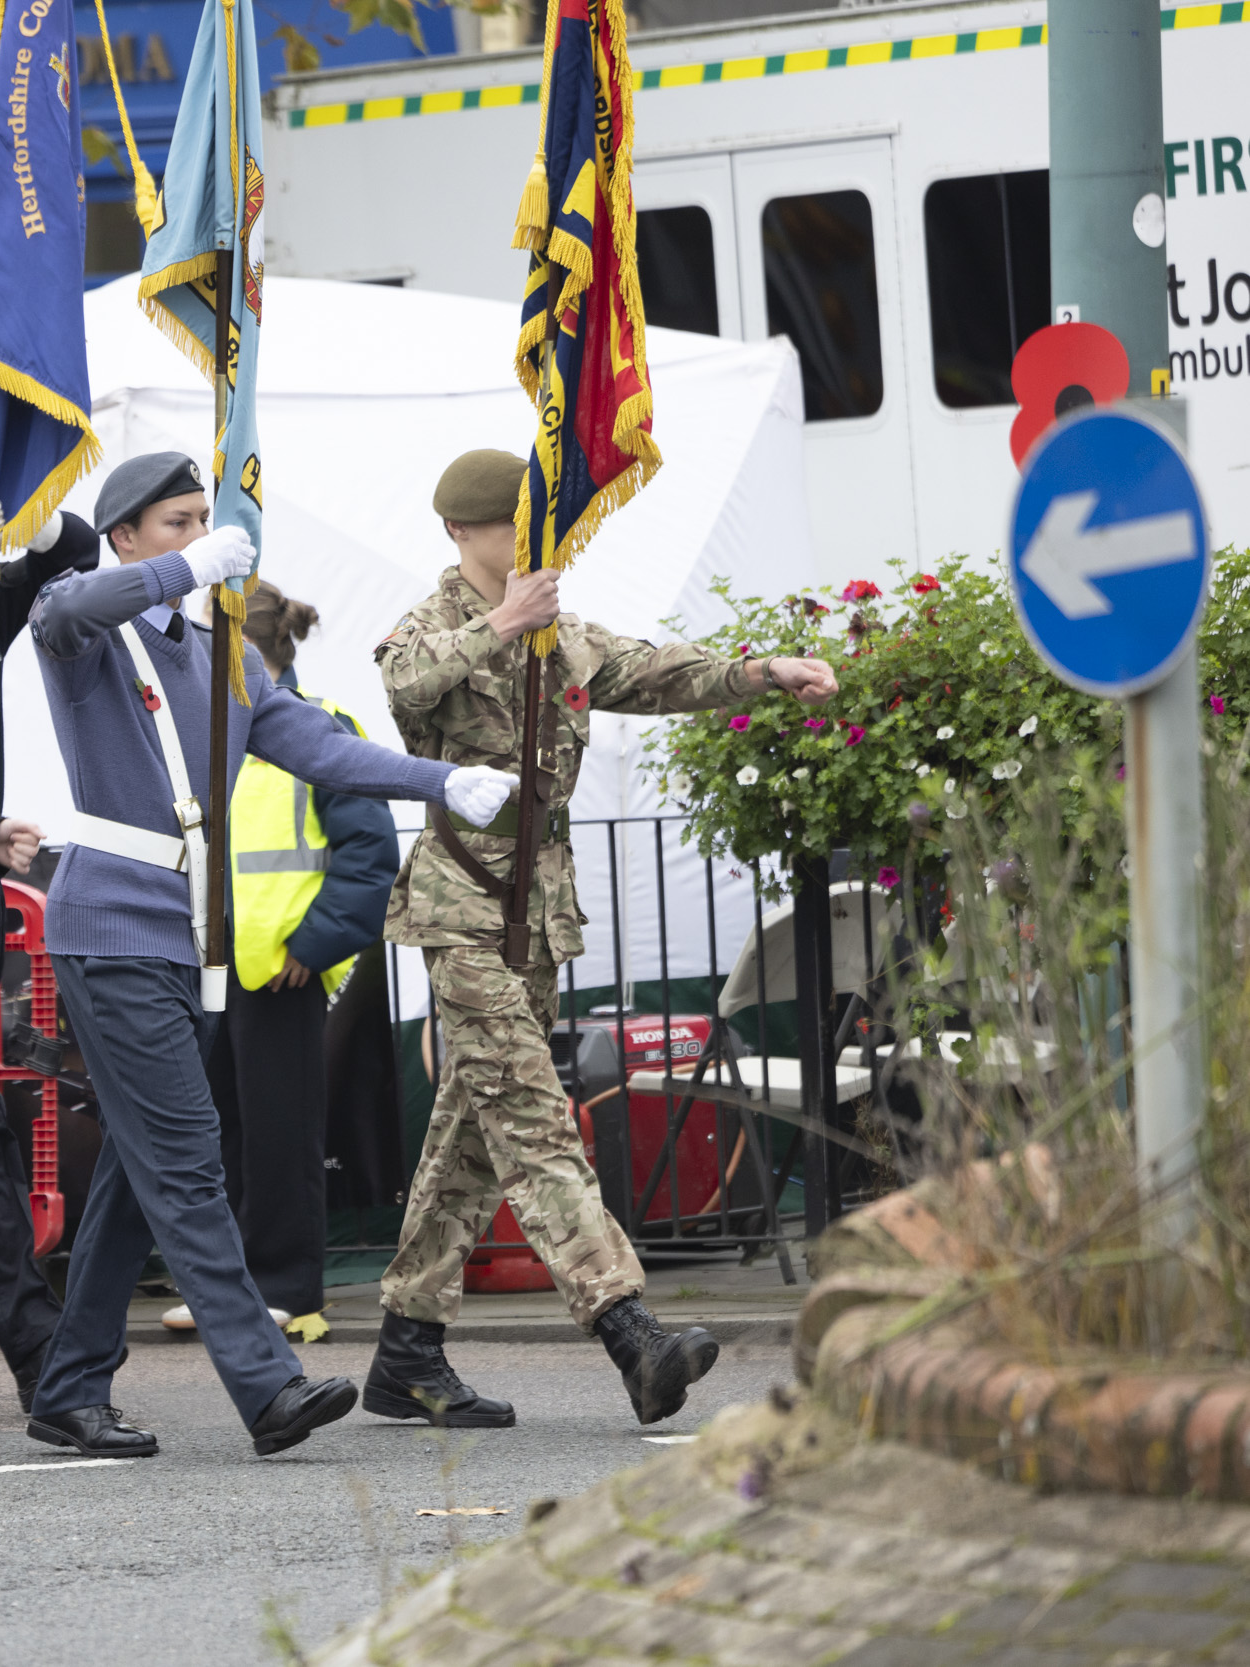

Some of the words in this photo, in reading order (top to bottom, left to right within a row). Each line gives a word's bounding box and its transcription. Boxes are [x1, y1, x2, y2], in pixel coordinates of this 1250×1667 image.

[19, 0, 54, 37] Co
[8, 48, 46, 239] Hertfordshire
[1164, 136, 1250, 199] FIR
[1167, 263, 1191, 328] t
[1201, 258, 1250, 327] Jo
[1169, 334, 1250, 383] mbul
[631, 1027, 693, 1043] HONDA
